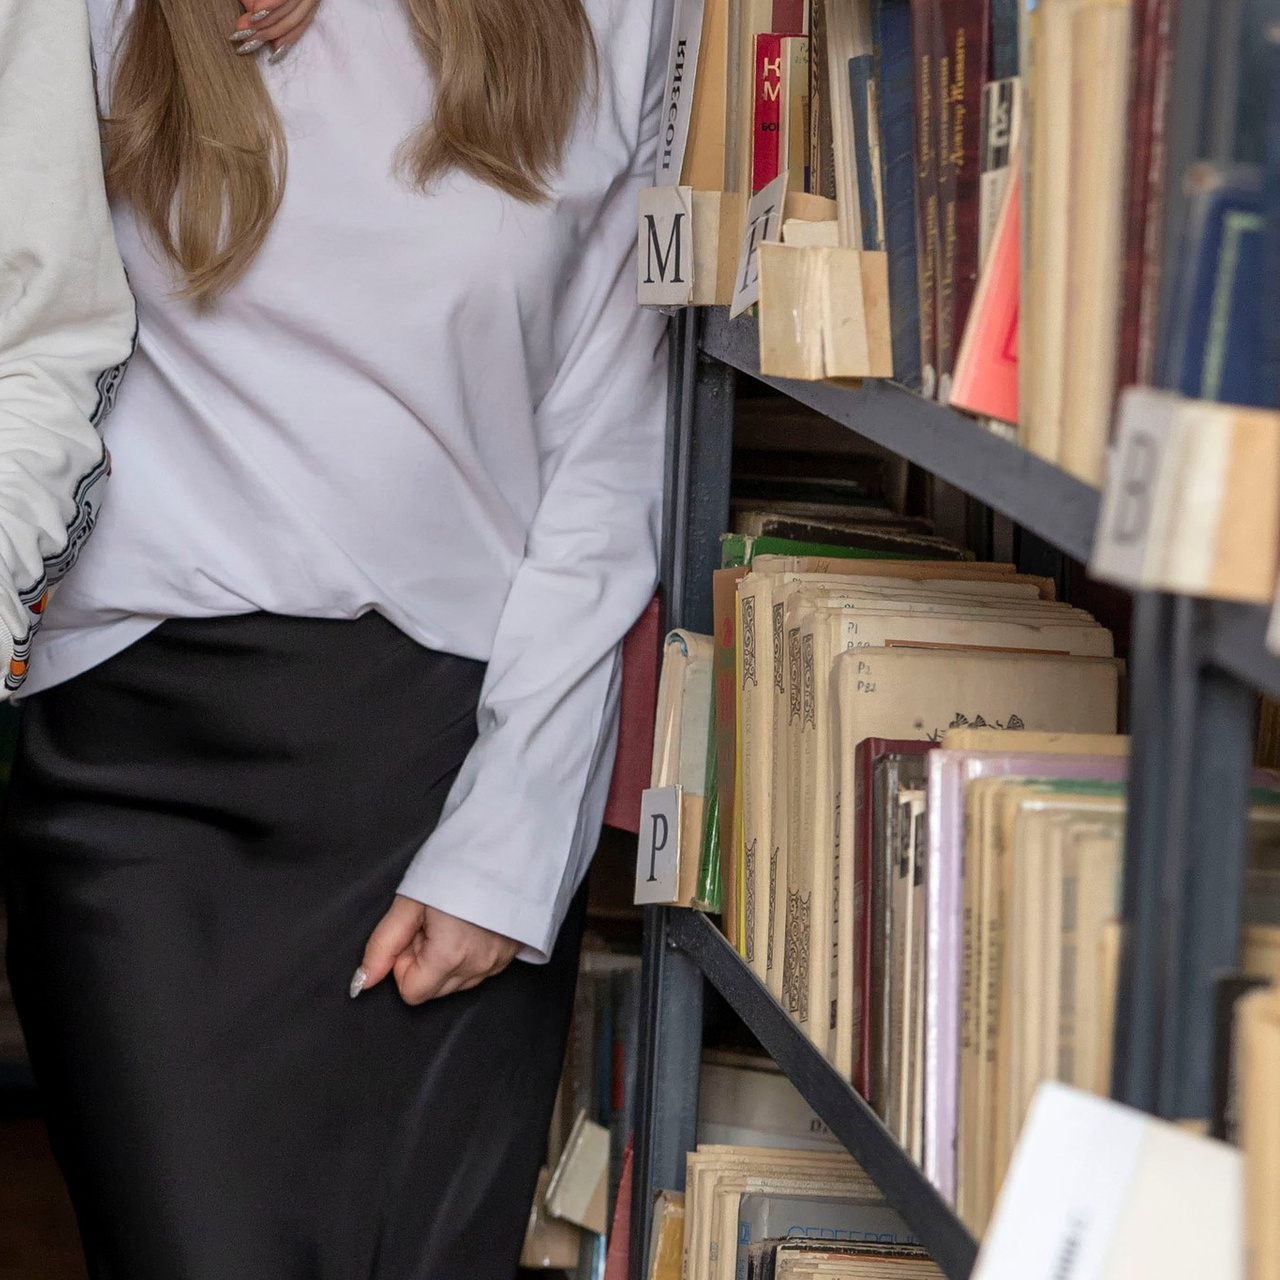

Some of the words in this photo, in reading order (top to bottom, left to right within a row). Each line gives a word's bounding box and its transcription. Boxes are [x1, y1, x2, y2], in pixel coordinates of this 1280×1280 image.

[662, 39, 688, 170] ПОЭЗИЯ
[643, 213, 686, 284] М
[646, 812, 669, 882] Р
